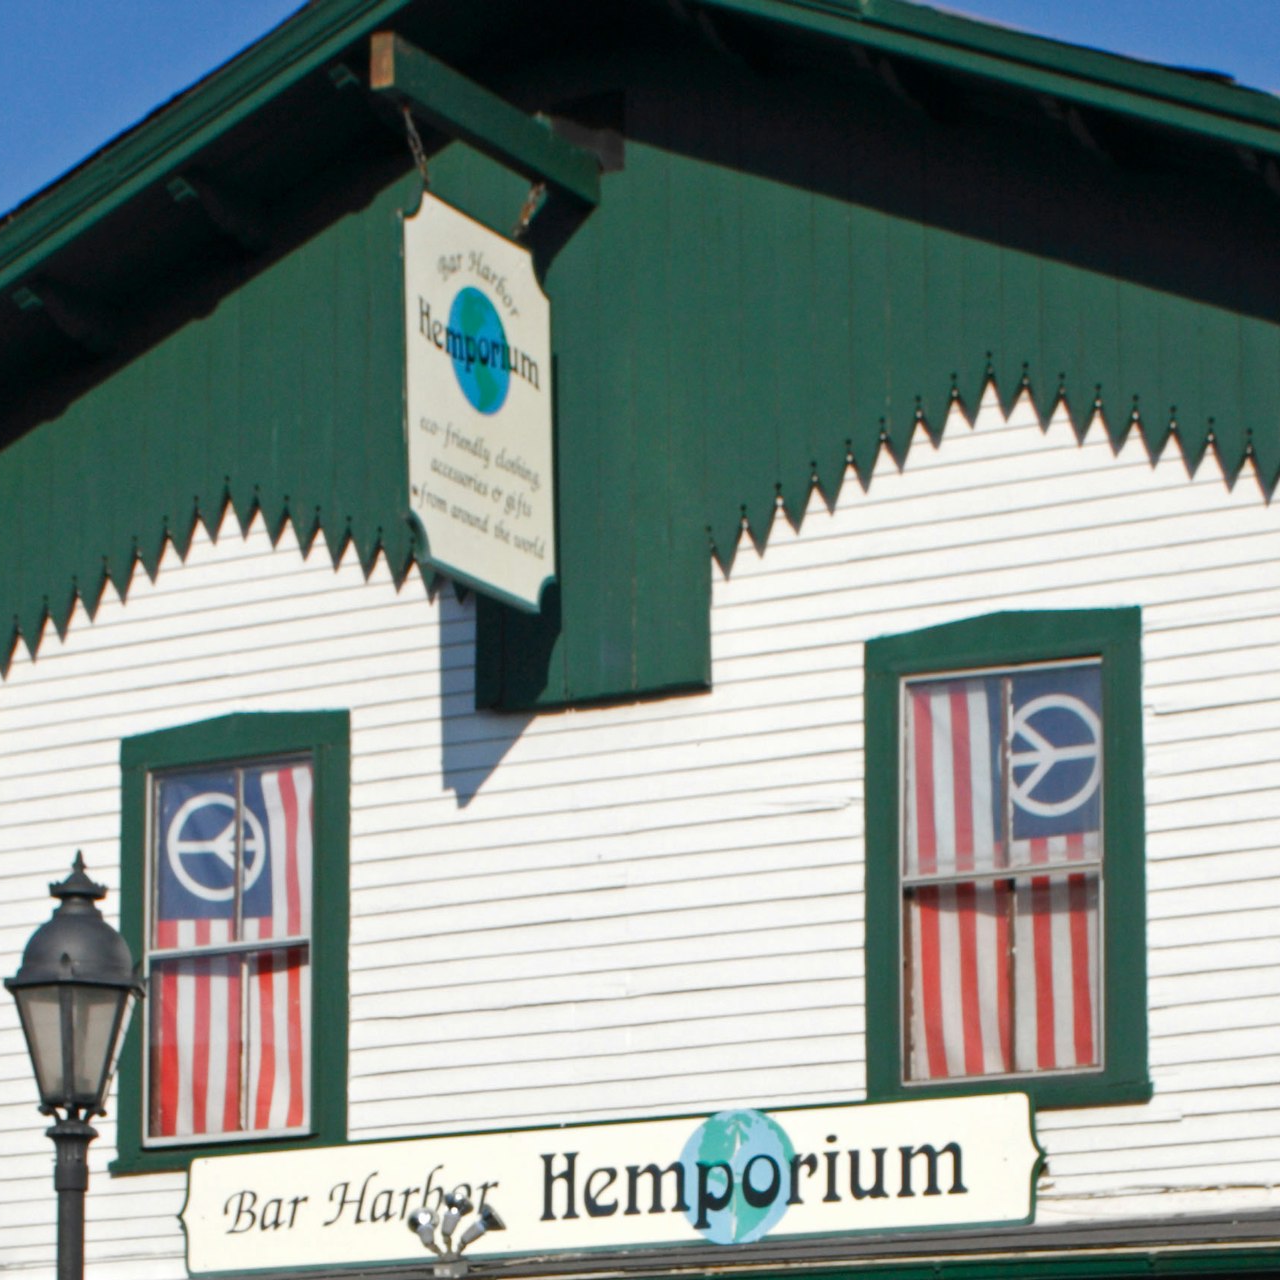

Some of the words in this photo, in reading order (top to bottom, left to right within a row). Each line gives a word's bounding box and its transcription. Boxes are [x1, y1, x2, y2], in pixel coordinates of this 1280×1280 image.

[469, 252, 519, 317] Harbor
[418, 294, 540, 391] Hemporium
[419, 482, 447, 513] from
[451, 505, 489, 533] around
[494, 519, 510, 544] the
[514, 536, 546, 560] world
[431, 458, 488, 497] accessories
[504, 492, 532, 519] gifts
[223, 1190, 308, 1234] Bar
[539, 1135, 968, 1229] Hemporium
